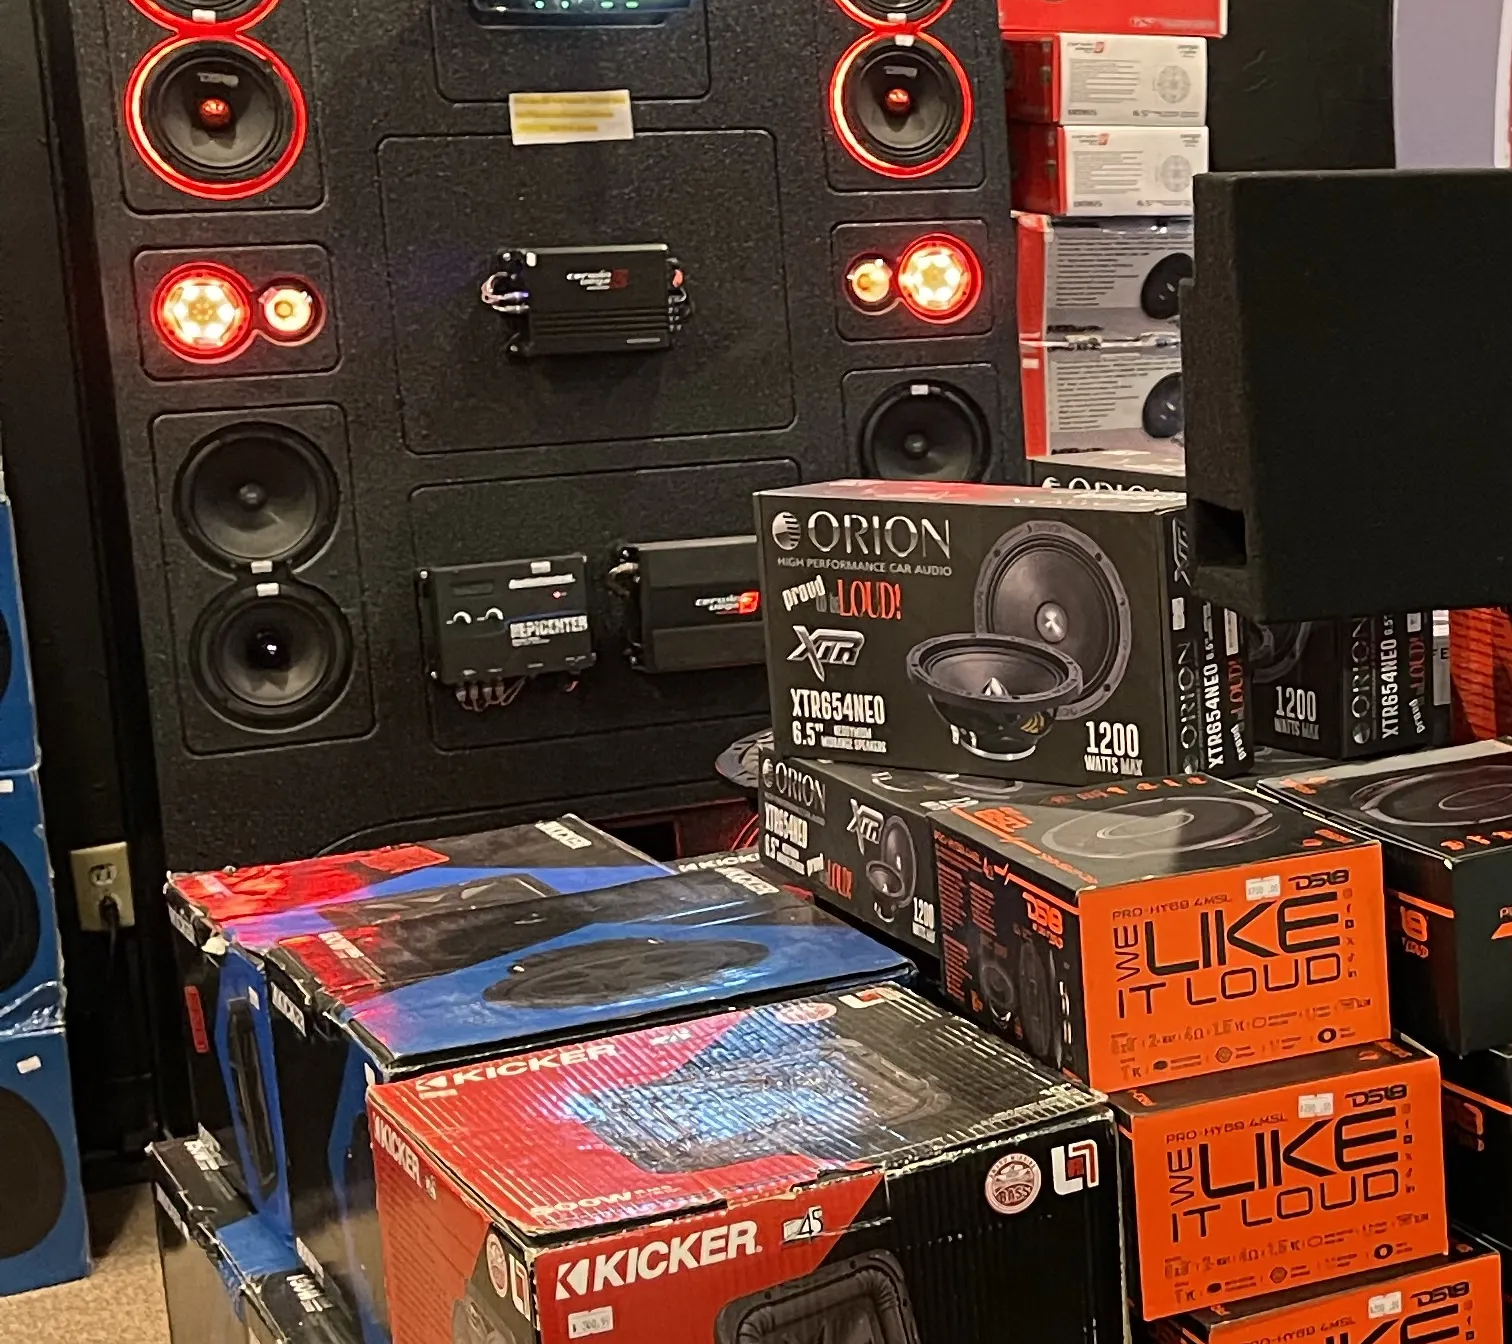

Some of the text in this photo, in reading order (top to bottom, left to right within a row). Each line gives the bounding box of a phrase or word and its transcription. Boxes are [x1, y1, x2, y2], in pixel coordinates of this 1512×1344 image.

[807, 510, 951, 560] ORION
[777, 557, 953, 577] HIGH PERFORMANCE CAR AUDIO
[782, 574, 903, 621] proud LOUD!
[1351, 617, 1371, 719] ORION
[1380, 638, 1399, 739] XTR654NEO
[790, 688, 886, 725] XTR654NEO
[1176, 640, 1198, 749] ORION
[1202, 662, 1224, 769] XTR654NEO
[1275, 685, 1317, 722] 1200
[1084, 720, 1140, 757] 1200
[775, 761, 826, 814] ORION
[1083, 754, 1143, 777] WATTS MAX
[1287, 868, 1350, 891] DS18
[912, 895, 936, 929] 1200
[1113, 890, 1341, 983] WE LIKE
[1118, 952, 1341, 1019] IT LOUD
[452, 1041, 617, 1087] KICKER
[1344, 1084, 1408, 1107] DS18
[1167, 1107, 1400, 1207] WE LIKE
[1172, 1168, 1400, 1243] IT LOUD
[593, 1220, 757, 1292] KICKER
[1409, 1280, 1470, 1307] DS18
